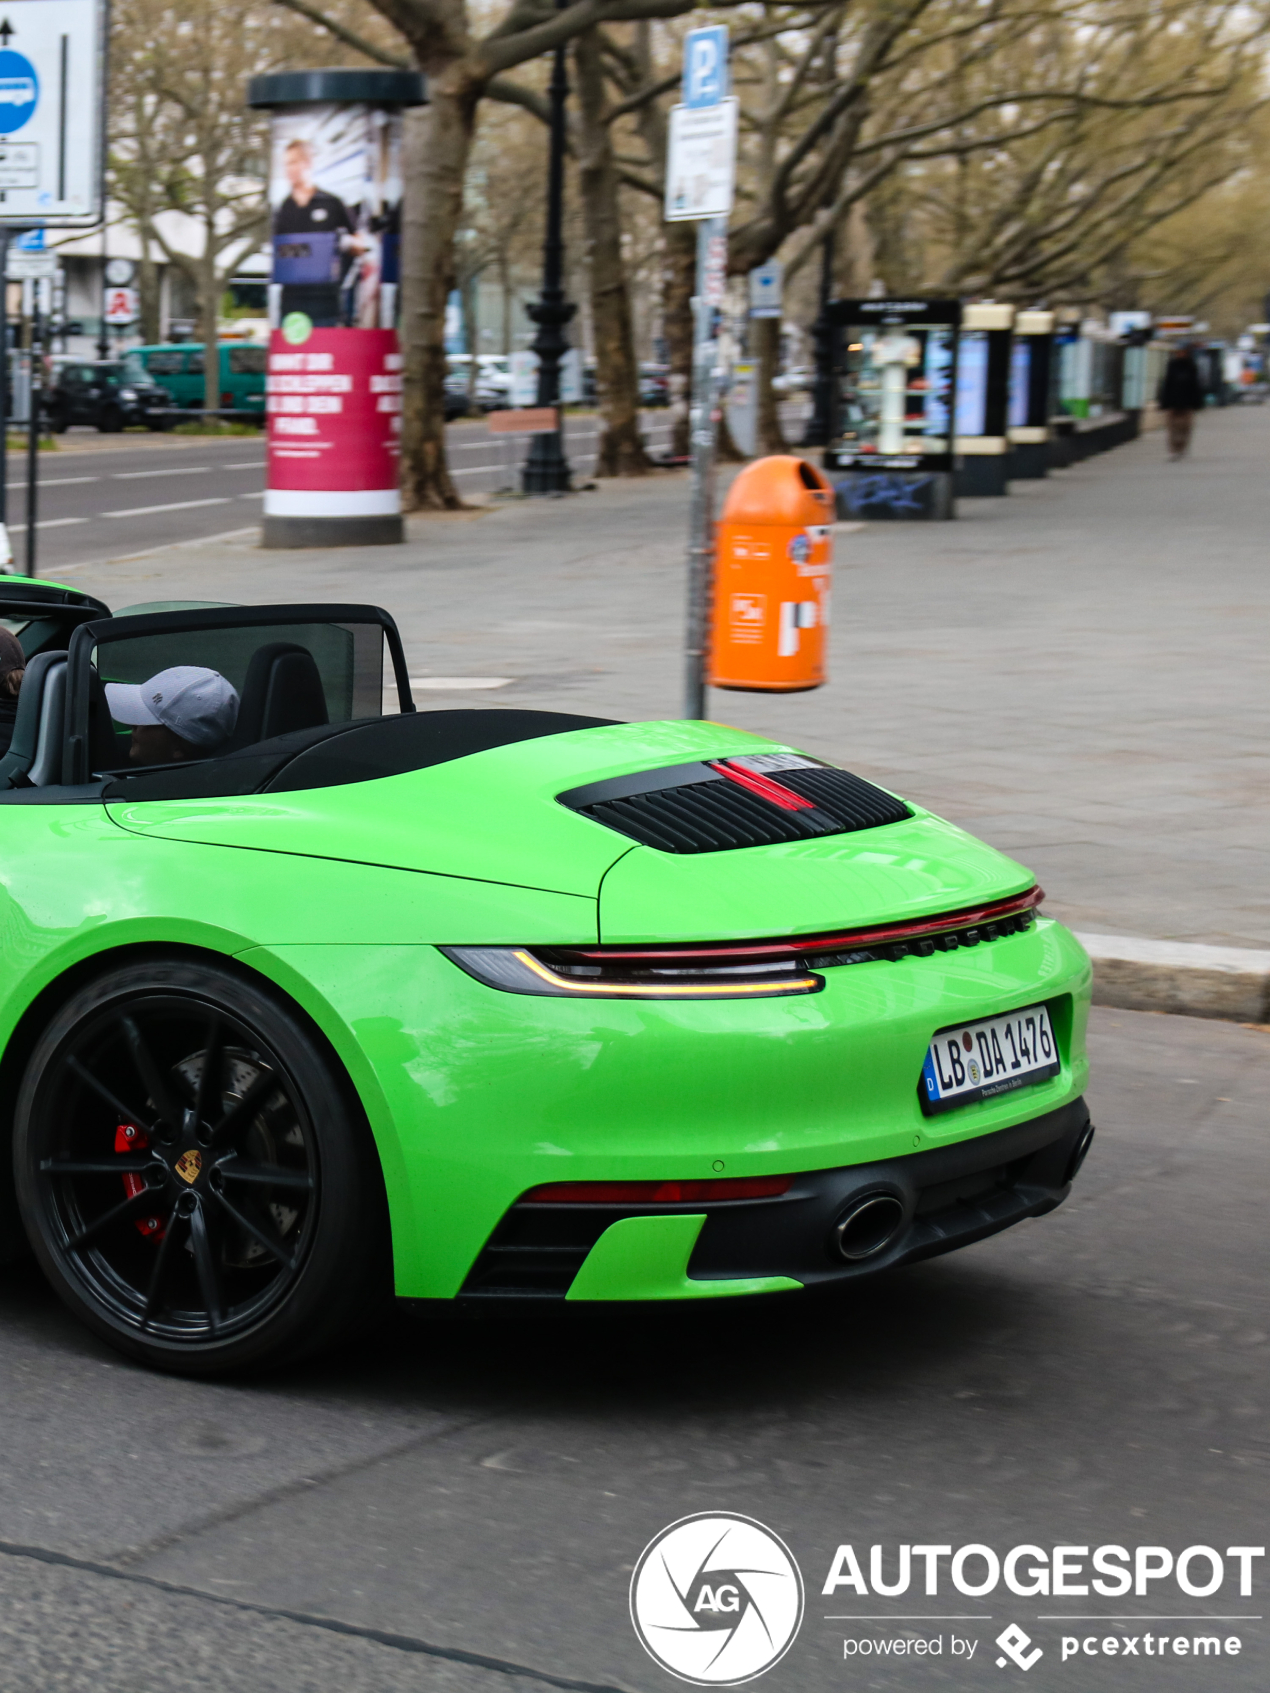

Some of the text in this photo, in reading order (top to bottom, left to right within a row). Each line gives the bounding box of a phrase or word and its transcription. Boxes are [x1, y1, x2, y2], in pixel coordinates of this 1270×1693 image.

[691, 39, 717, 97] P
[933, 1014, 1051, 1091] LB DA 1476
[926, 1077, 934, 1091] D
